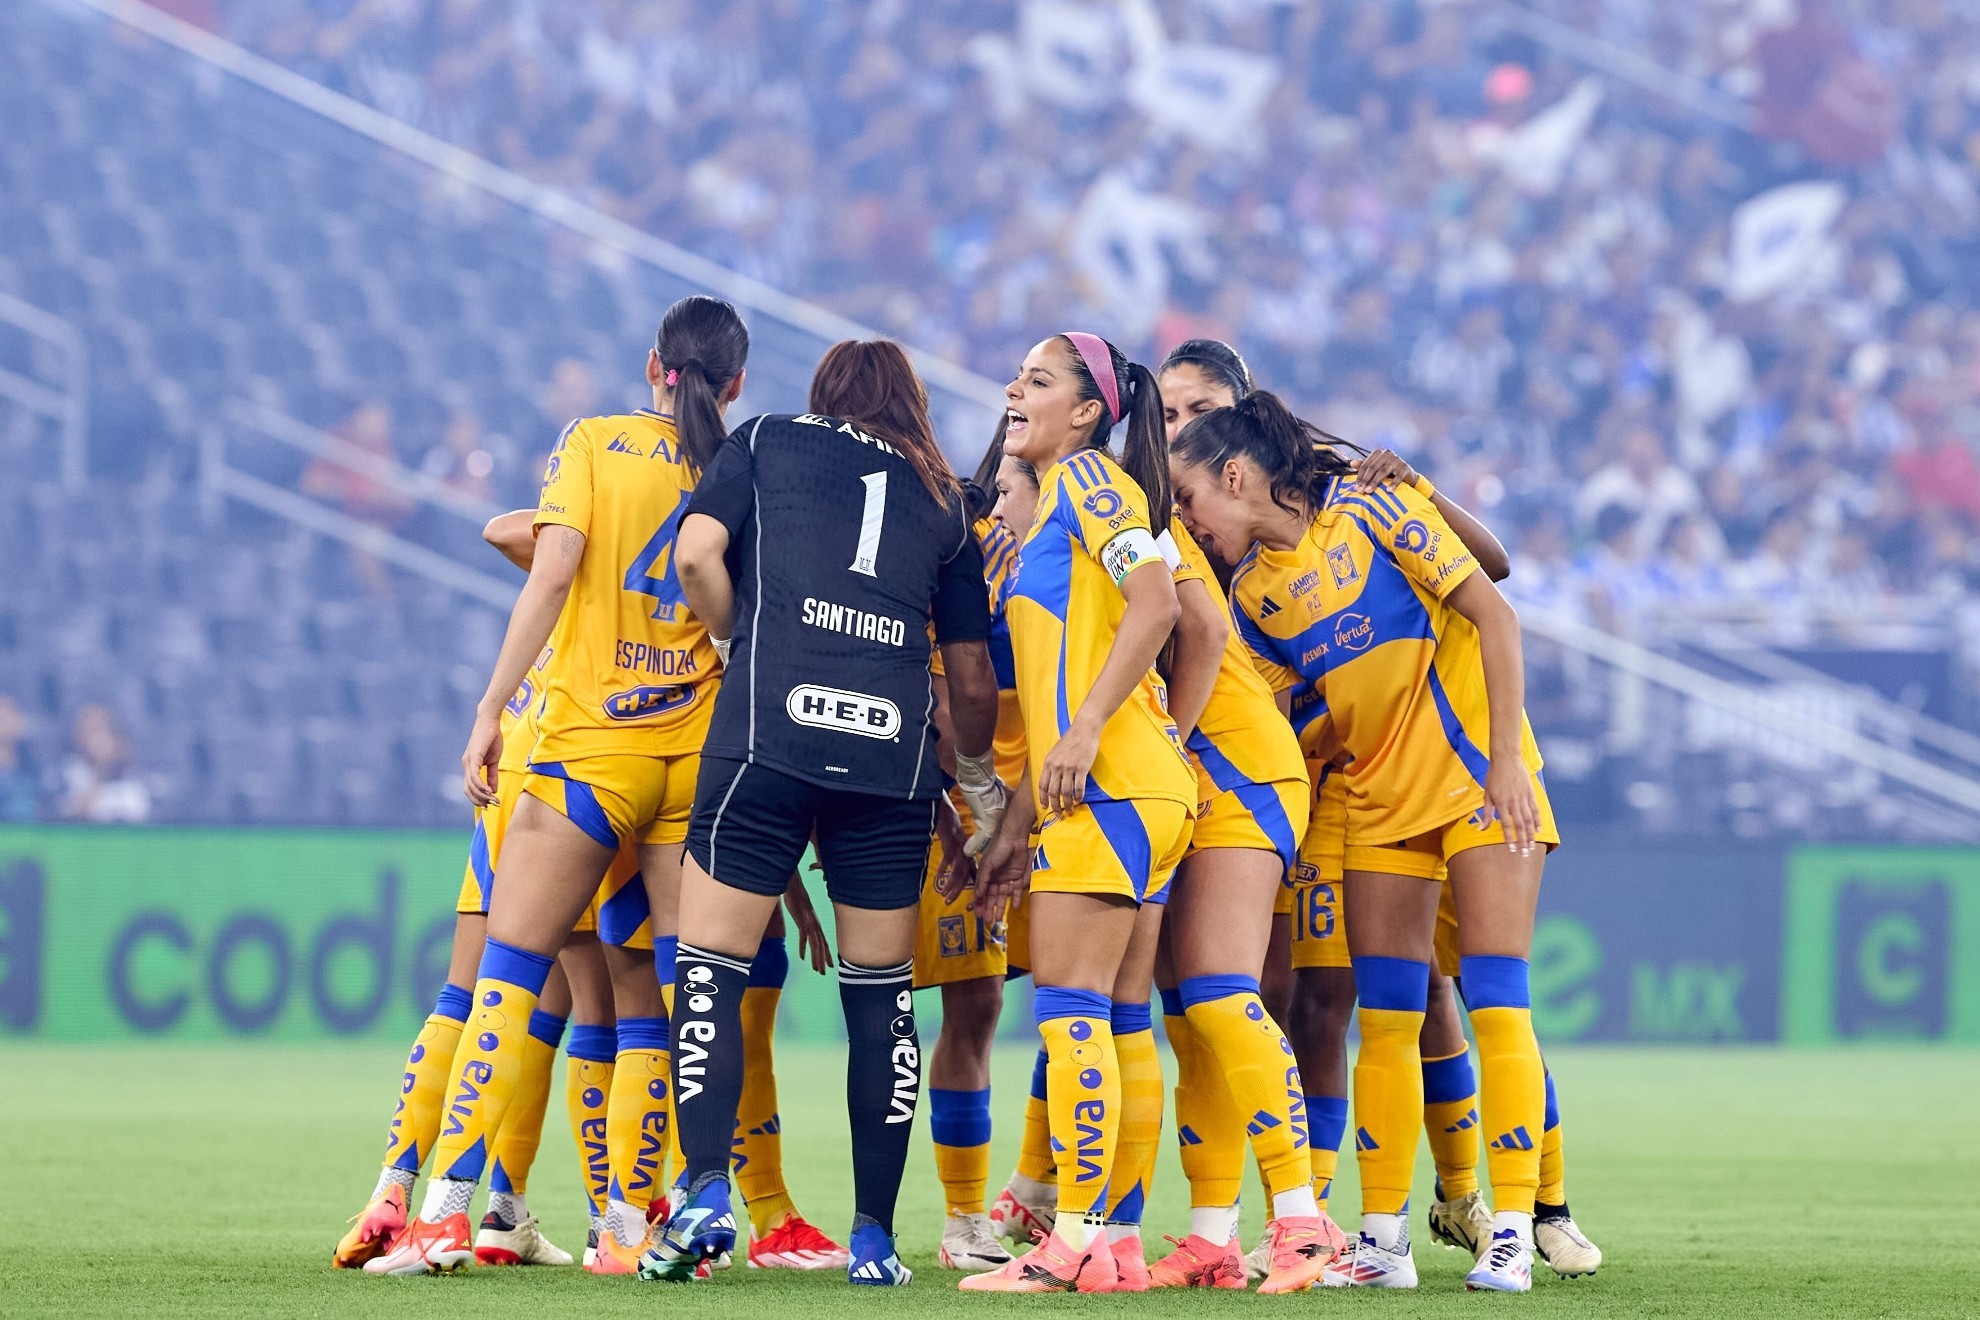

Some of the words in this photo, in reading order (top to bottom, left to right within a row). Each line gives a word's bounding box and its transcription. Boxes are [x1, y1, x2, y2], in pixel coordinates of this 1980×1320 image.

[623, 489, 694, 623] 4
[848, 471, 887, 578] 1
[1109, 505, 1135, 530] Berel
[1424, 530, 1442, 562] Berel
[1437, 553, 1471, 580] Hortons
[615, 639, 697, 676] ESPINOZA
[802, 597, 905, 647] SANTIAGO
[1296, 884, 1336, 941] 16
[443, 1060, 493, 1136] viva
[679, 1021, 716, 1104] viva
[885, 1045, 918, 1123] viva
[581, 1118, 608, 1196] viva
[628, 1112, 667, 1190] viva
[1075, 1100, 1105, 1182] viva
